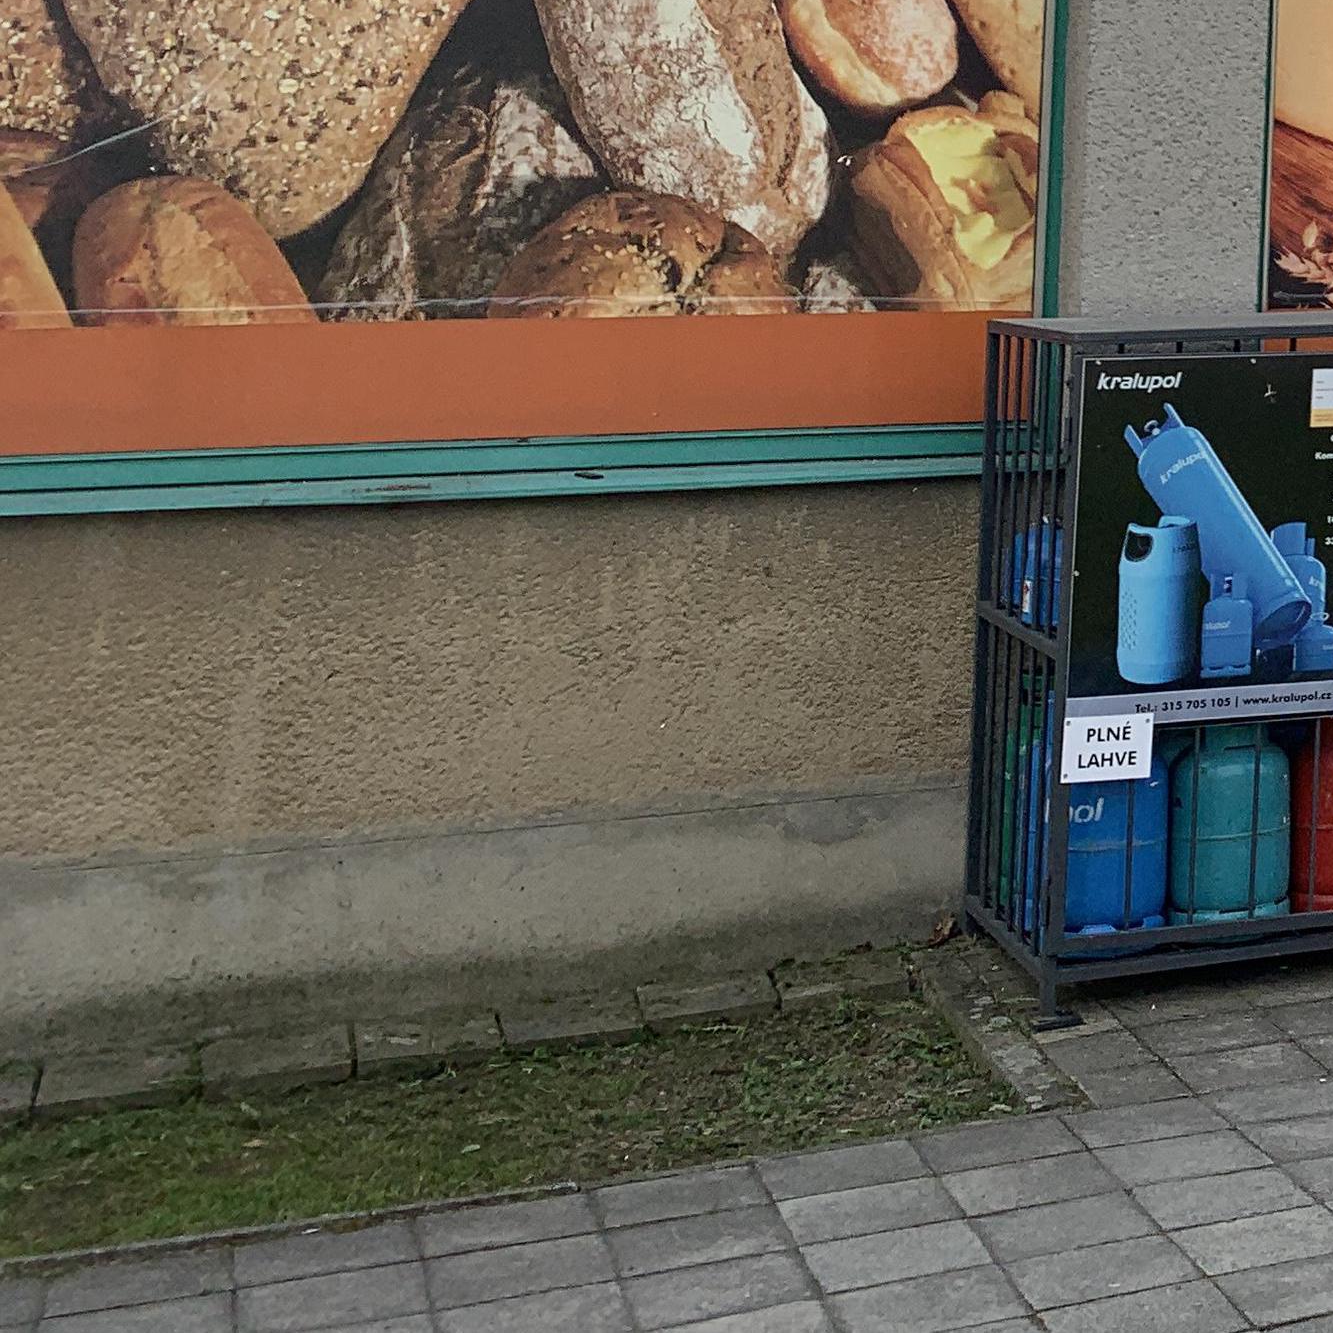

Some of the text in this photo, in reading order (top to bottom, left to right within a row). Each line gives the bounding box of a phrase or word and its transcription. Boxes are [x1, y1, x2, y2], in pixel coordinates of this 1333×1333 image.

[1096, 371, 1183, 393] kralupol
[1161, 701, 1183, 712] 315
[1186, 699, 1207, 710] 705
[1210, 697, 1231, 708] 105
[1242, 690, 1333, 706] www.kralupol.cz
[1086, 721, 1132, 743] PLNÉ
[1077, 750, 1138, 769] LAHVE
